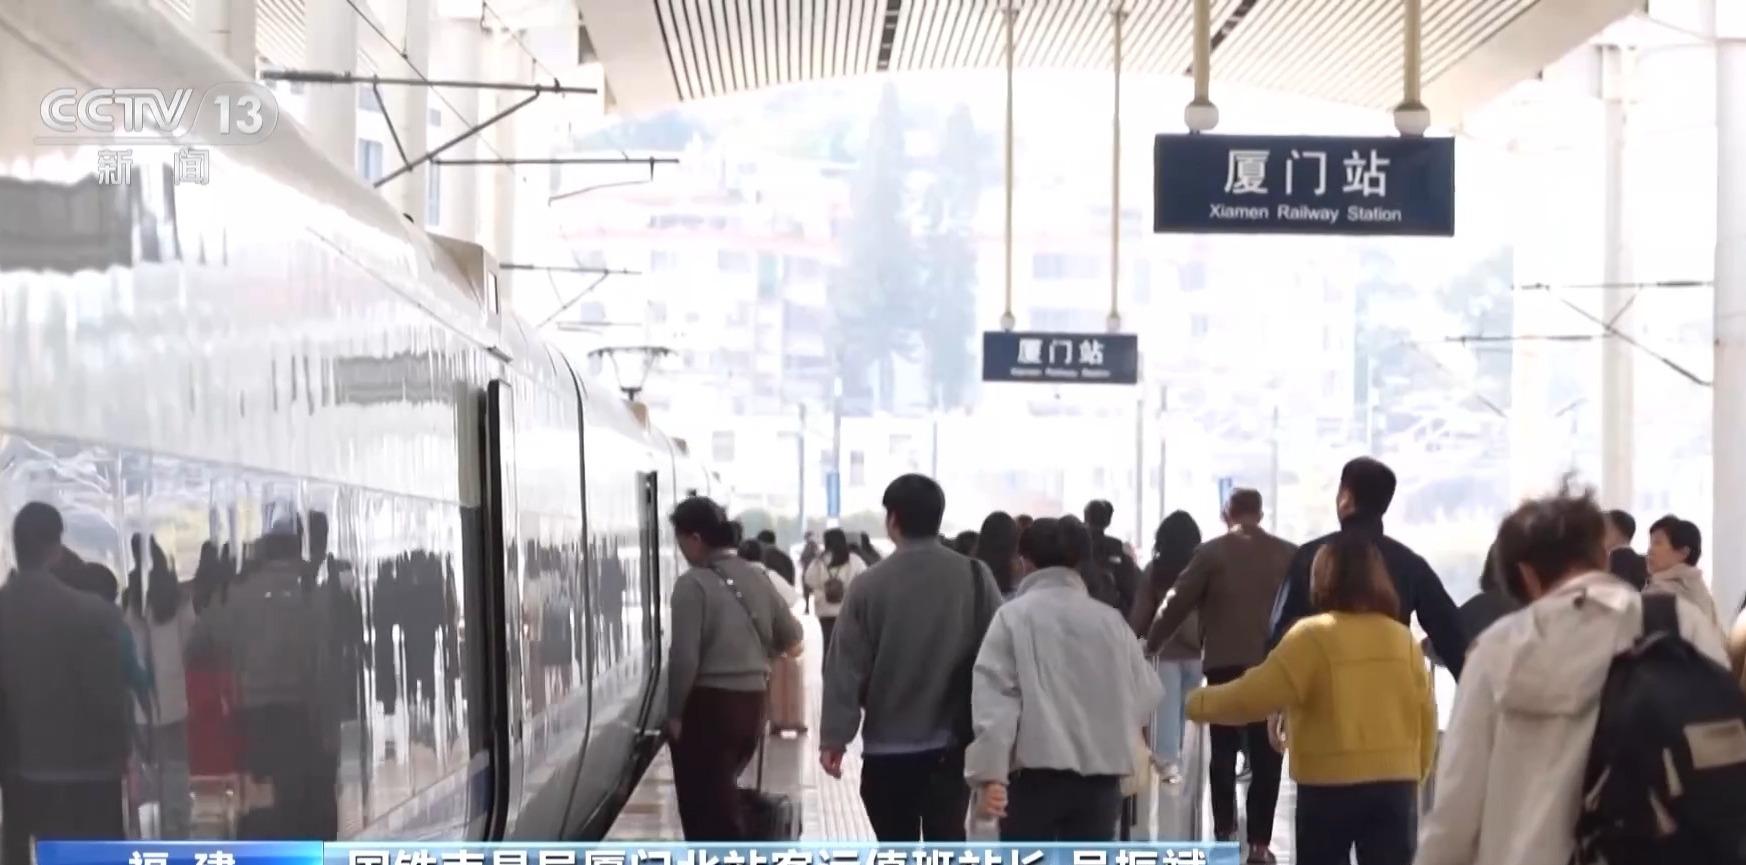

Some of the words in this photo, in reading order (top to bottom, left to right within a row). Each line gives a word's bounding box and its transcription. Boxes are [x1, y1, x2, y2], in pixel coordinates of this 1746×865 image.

[1224, 149, 1390, 197] 厦门站
[1209, 204, 1269, 220] Xiamen
[1277, 204, 1340, 224] Railway
[1347, 204, 1402, 222] Station
